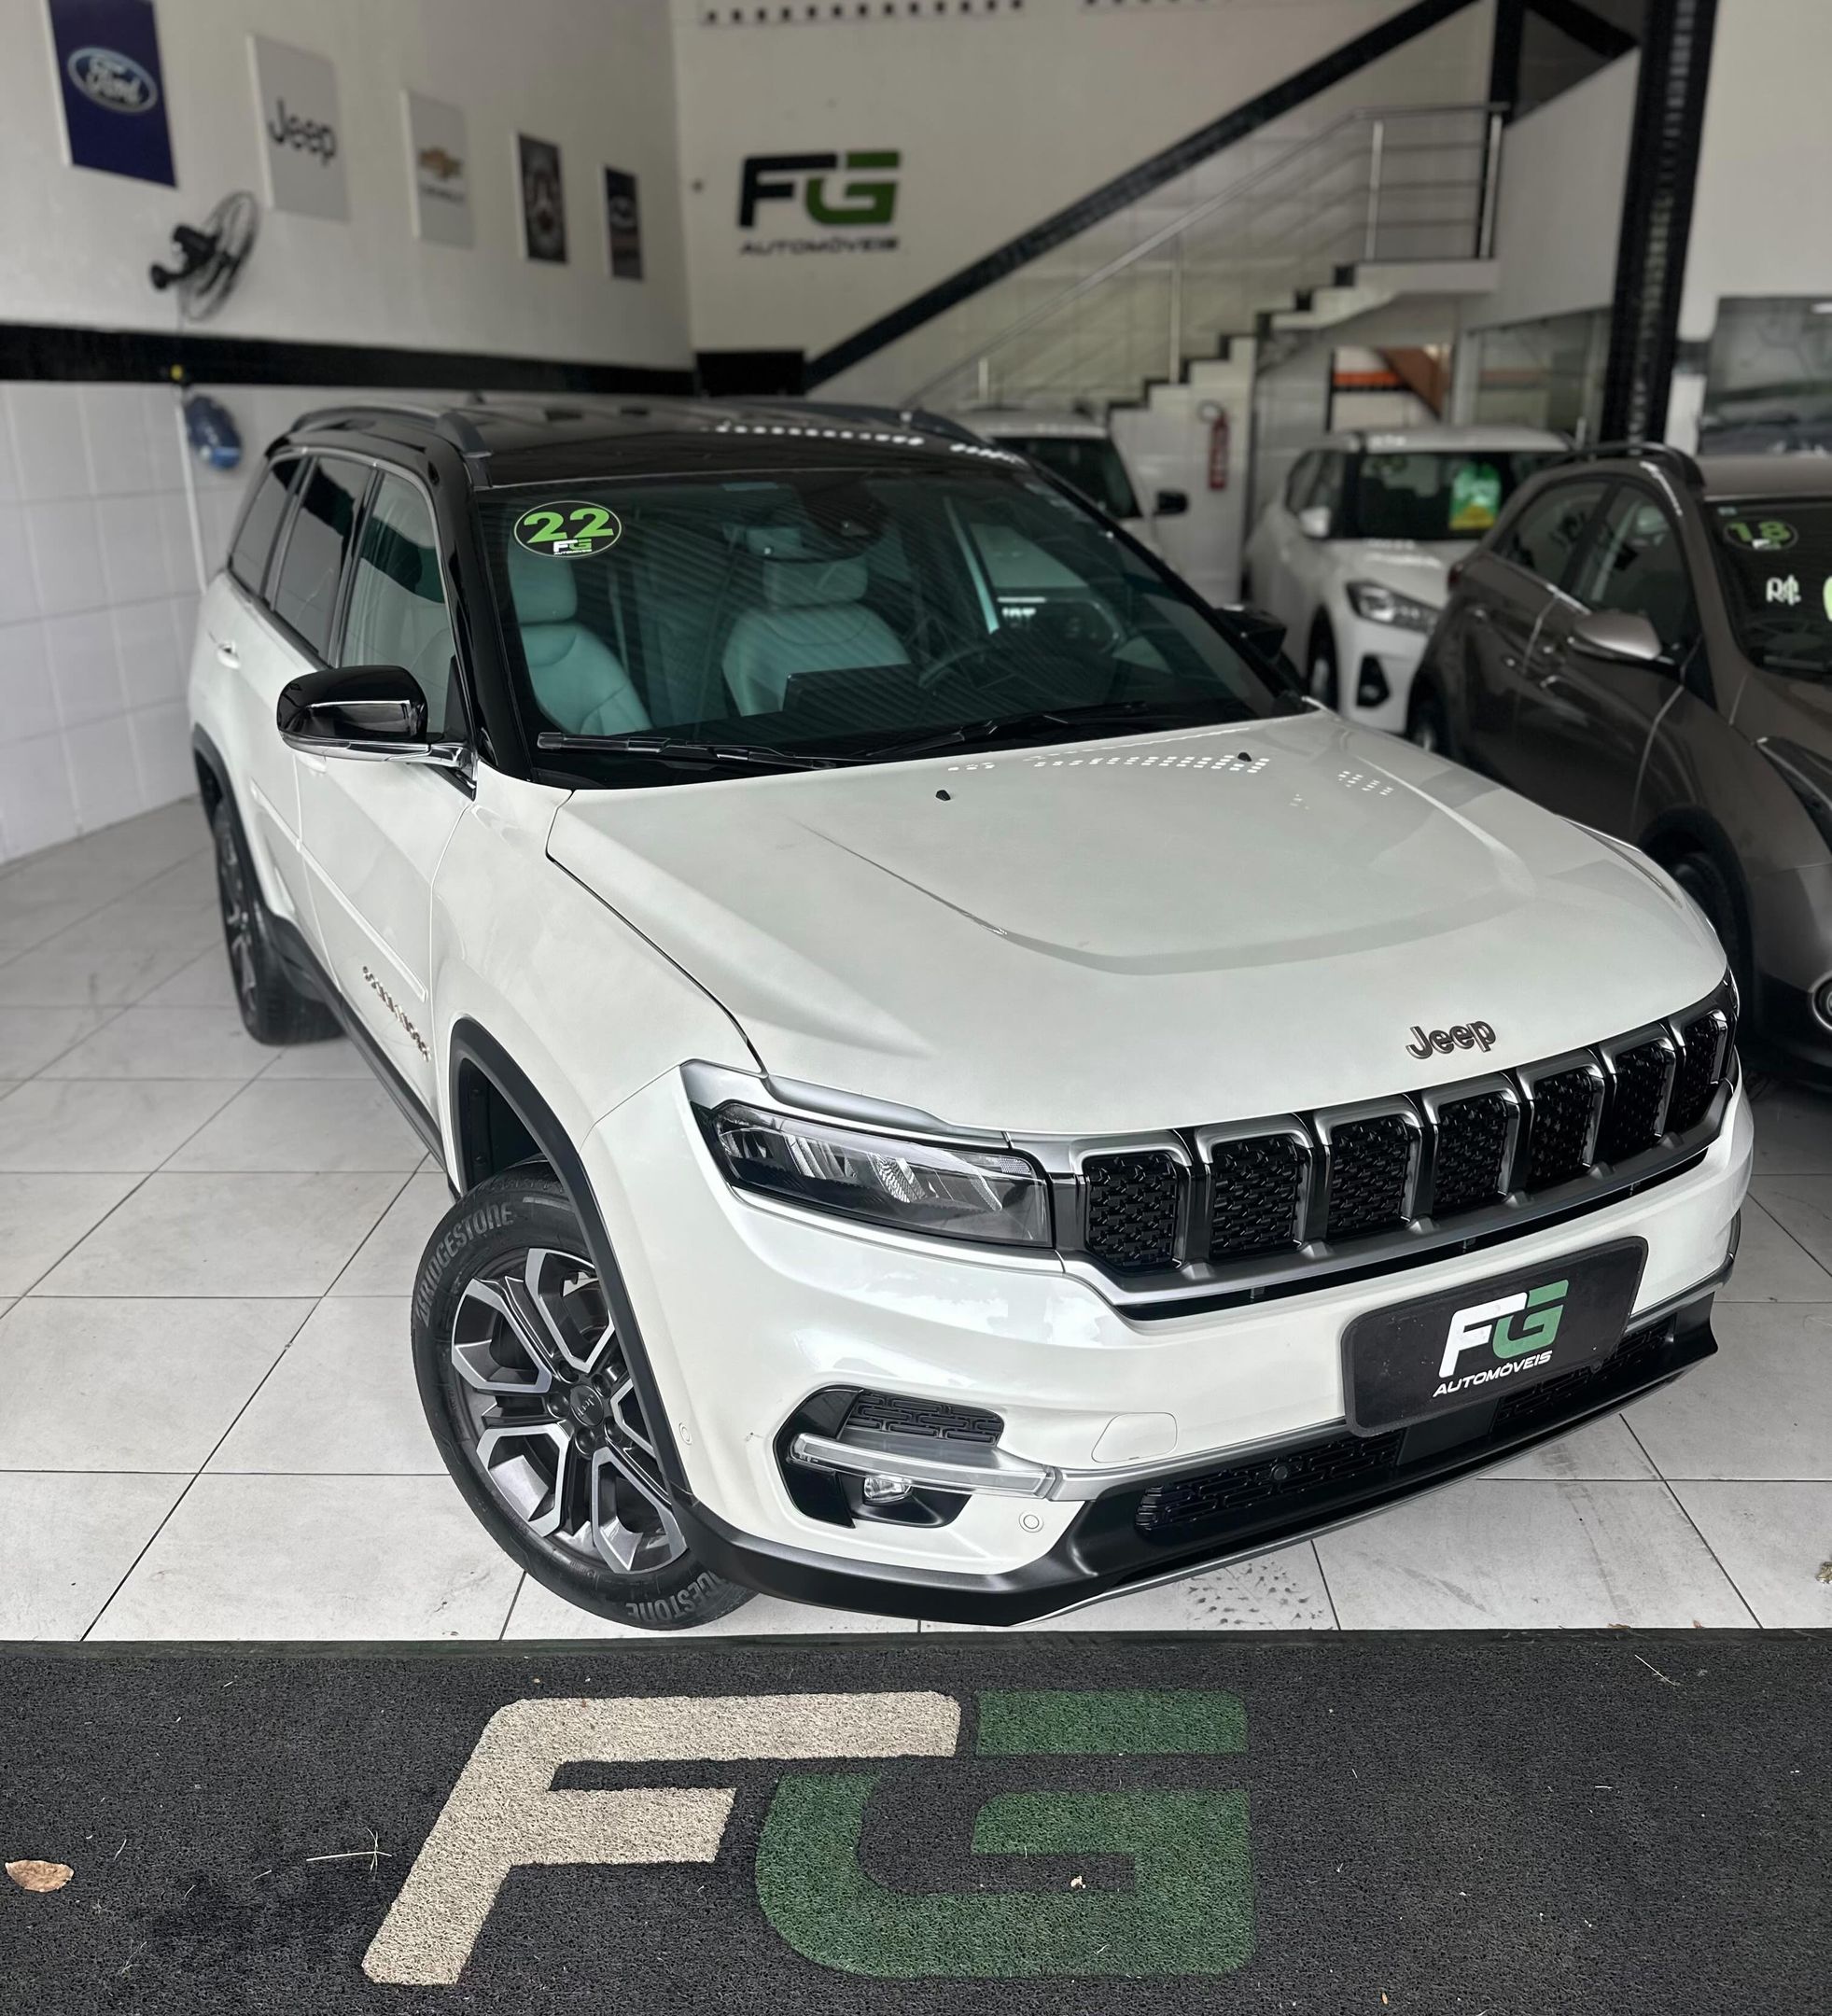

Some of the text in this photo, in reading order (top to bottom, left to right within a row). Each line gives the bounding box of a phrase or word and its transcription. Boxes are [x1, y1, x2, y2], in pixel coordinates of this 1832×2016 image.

[84, 56, 140, 105] Ford
[267, 98, 337, 167] Jeep
[738, 150, 900, 228] FG
[524, 507, 615, 544] 22
[553, 539, 592, 553] FG
[1729, 522, 1791, 542] 18
[1405, 1020, 1497, 1060] Jeep
[1438, 1280, 1570, 1379] FG
[1432, 1350, 1553, 1398] AUTOMÓVEIS
[361, 1690, 1257, 1986] FG
